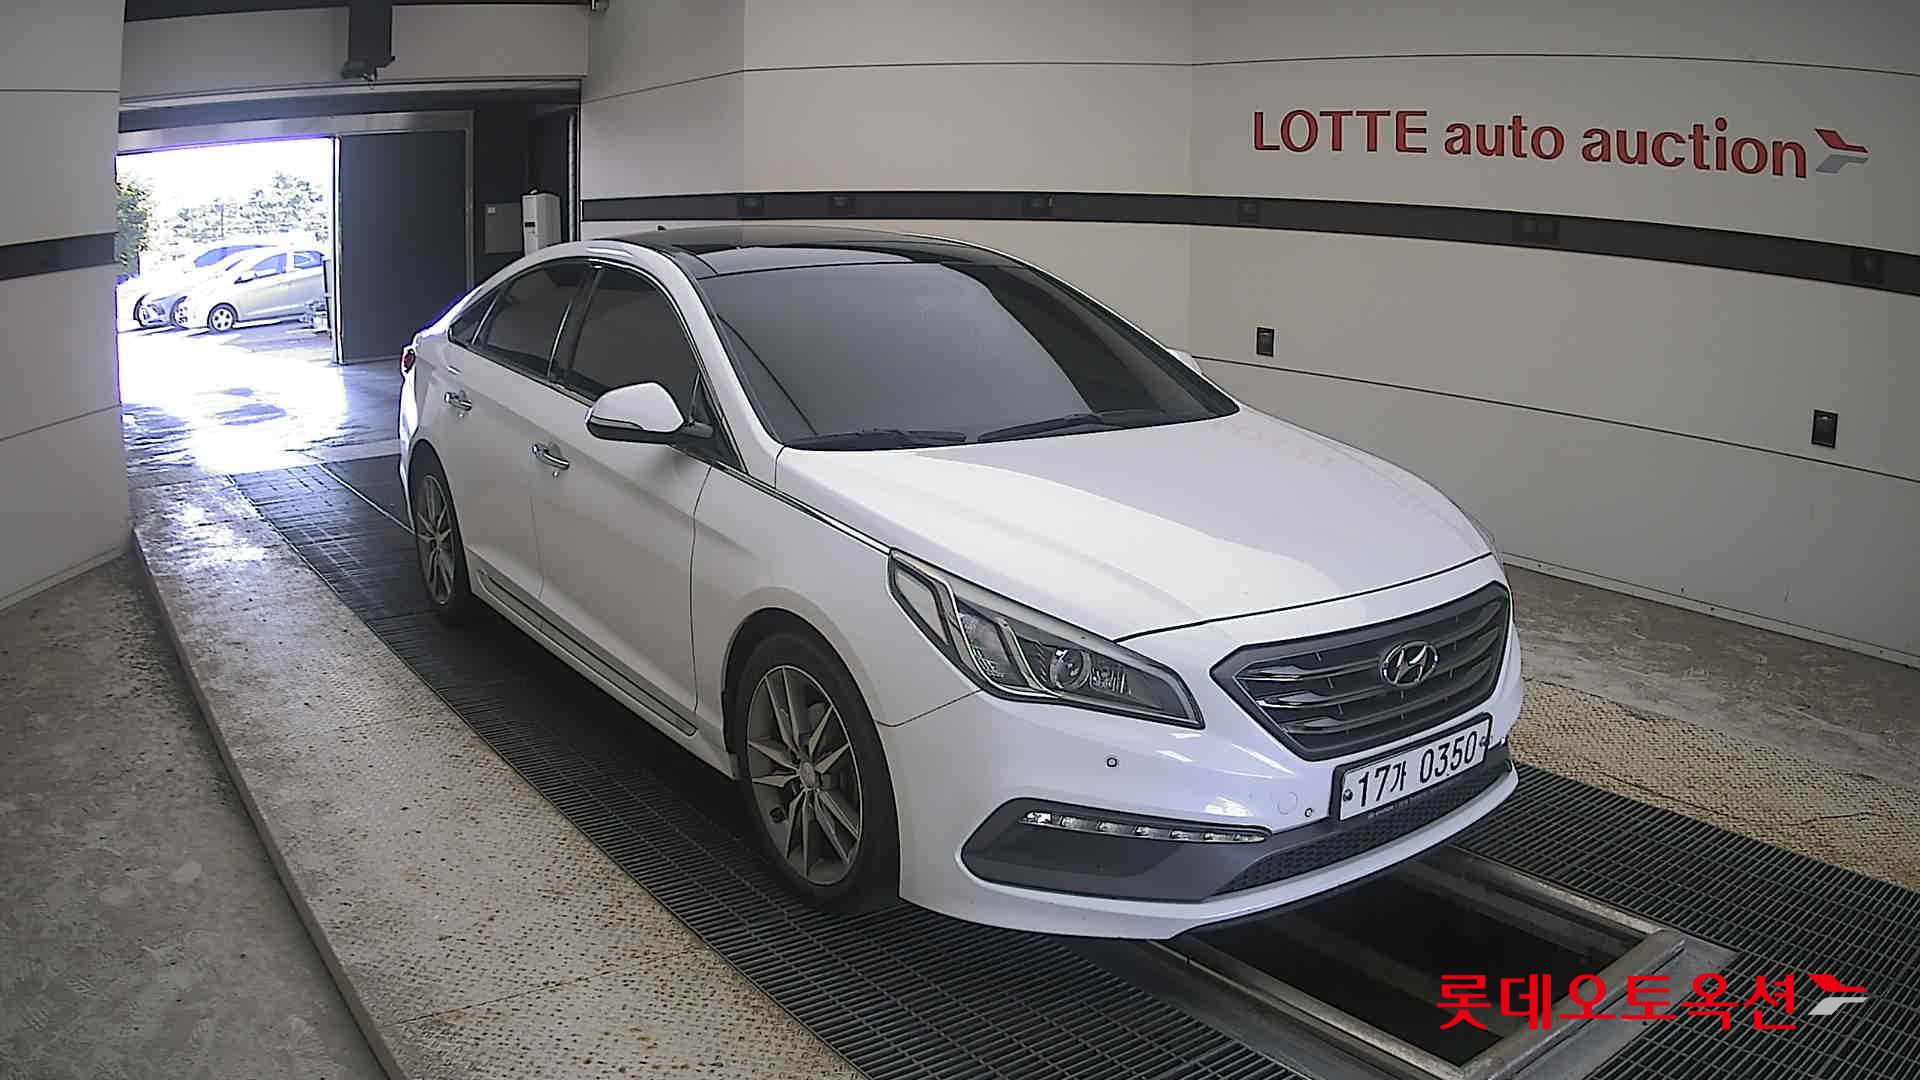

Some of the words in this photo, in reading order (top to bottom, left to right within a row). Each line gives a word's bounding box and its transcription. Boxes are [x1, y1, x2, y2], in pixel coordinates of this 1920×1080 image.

[1254, 110, 1427, 153] LOTTE
[1444, 115, 1565, 160] auto
[1582, 118, 1807, 178] auction
[1358, 760, 1407, 807] 17가
[1420, 731, 1477, 783] 0350
